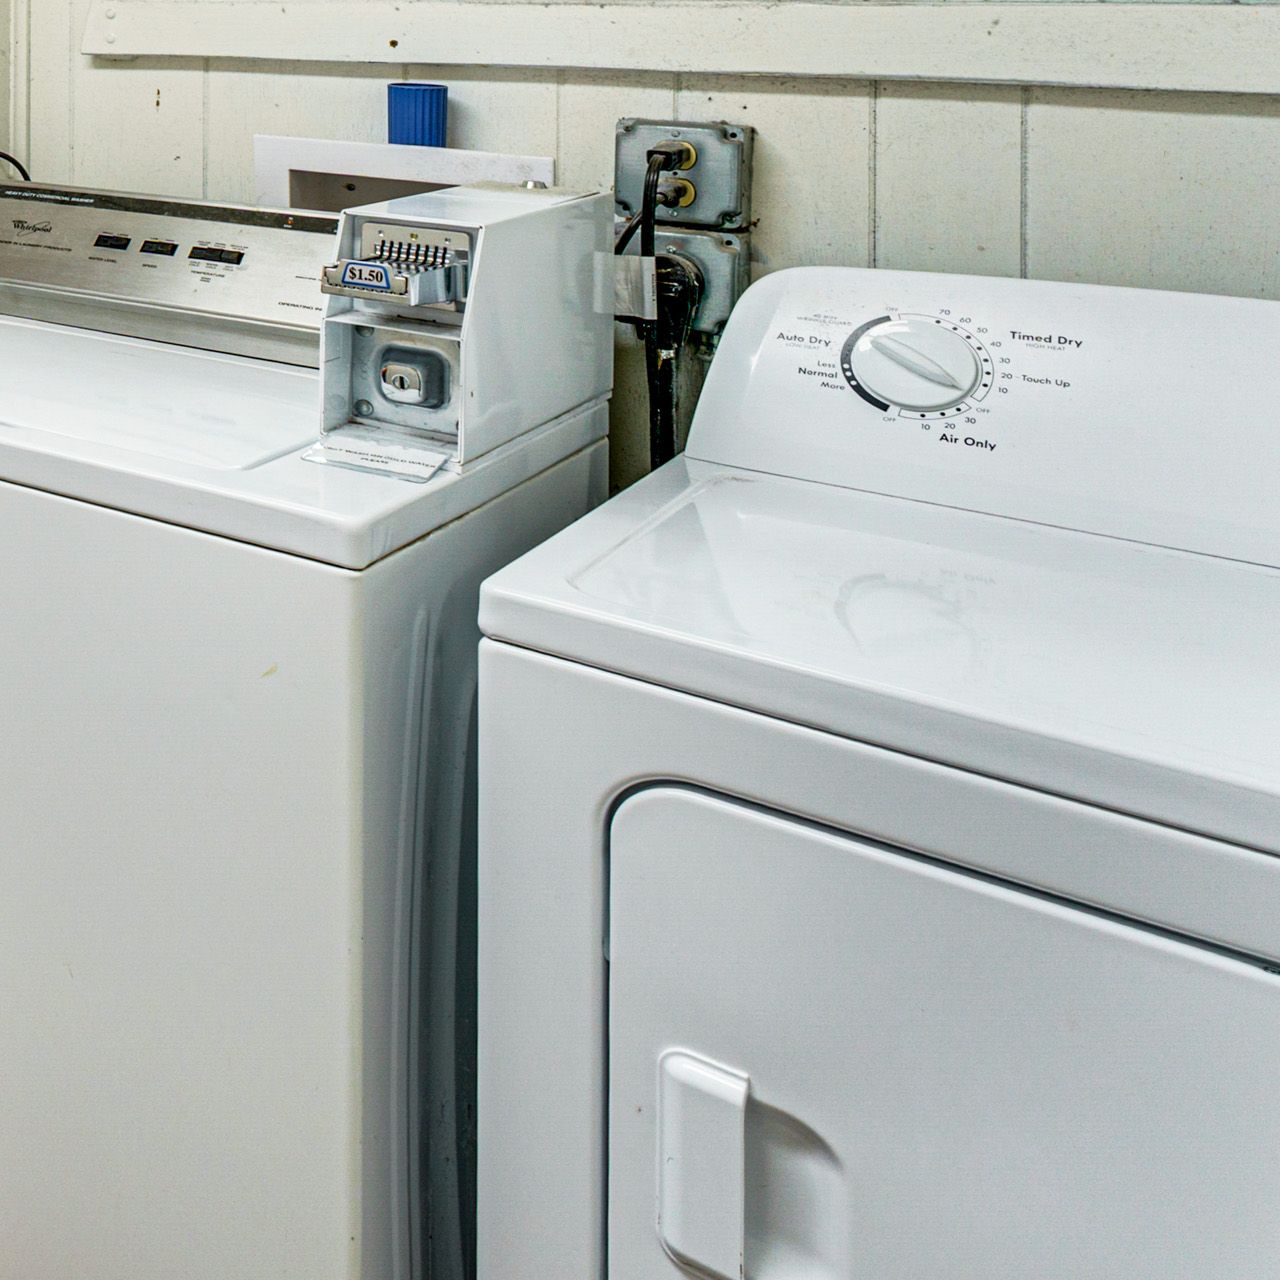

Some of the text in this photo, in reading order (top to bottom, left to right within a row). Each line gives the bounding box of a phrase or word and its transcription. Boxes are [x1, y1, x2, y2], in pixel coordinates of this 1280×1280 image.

[12, 220, 53, 234] Whirlpool
[191, 270, 225, 278] TEMPERATURE
[348, 266, 384, 283] $1.50
[278, 302, 314, 310] OPERATING
[939, 308, 951, 316] 70
[959, 316, 972, 324] 60
[976, 326, 989, 334] 50
[776, 332, 832, 347] Auto Dry
[1010, 330, 1083, 349] Timed Dry
[1025, 342, 1066, 352] HIGH HEAT
[817, 360, 836, 369] Less
[999, 357, 1011, 365] 30
[797, 367, 838, 379] Normal
[1001, 372, 1071, 389] 20 Touch Up
[820, 381, 846, 391] More
[964, 417, 977, 425] 30
[921, 423, 931, 431] 10
[944, 422, 957, 430] 20
[939, 433, 997, 452] Air Only
